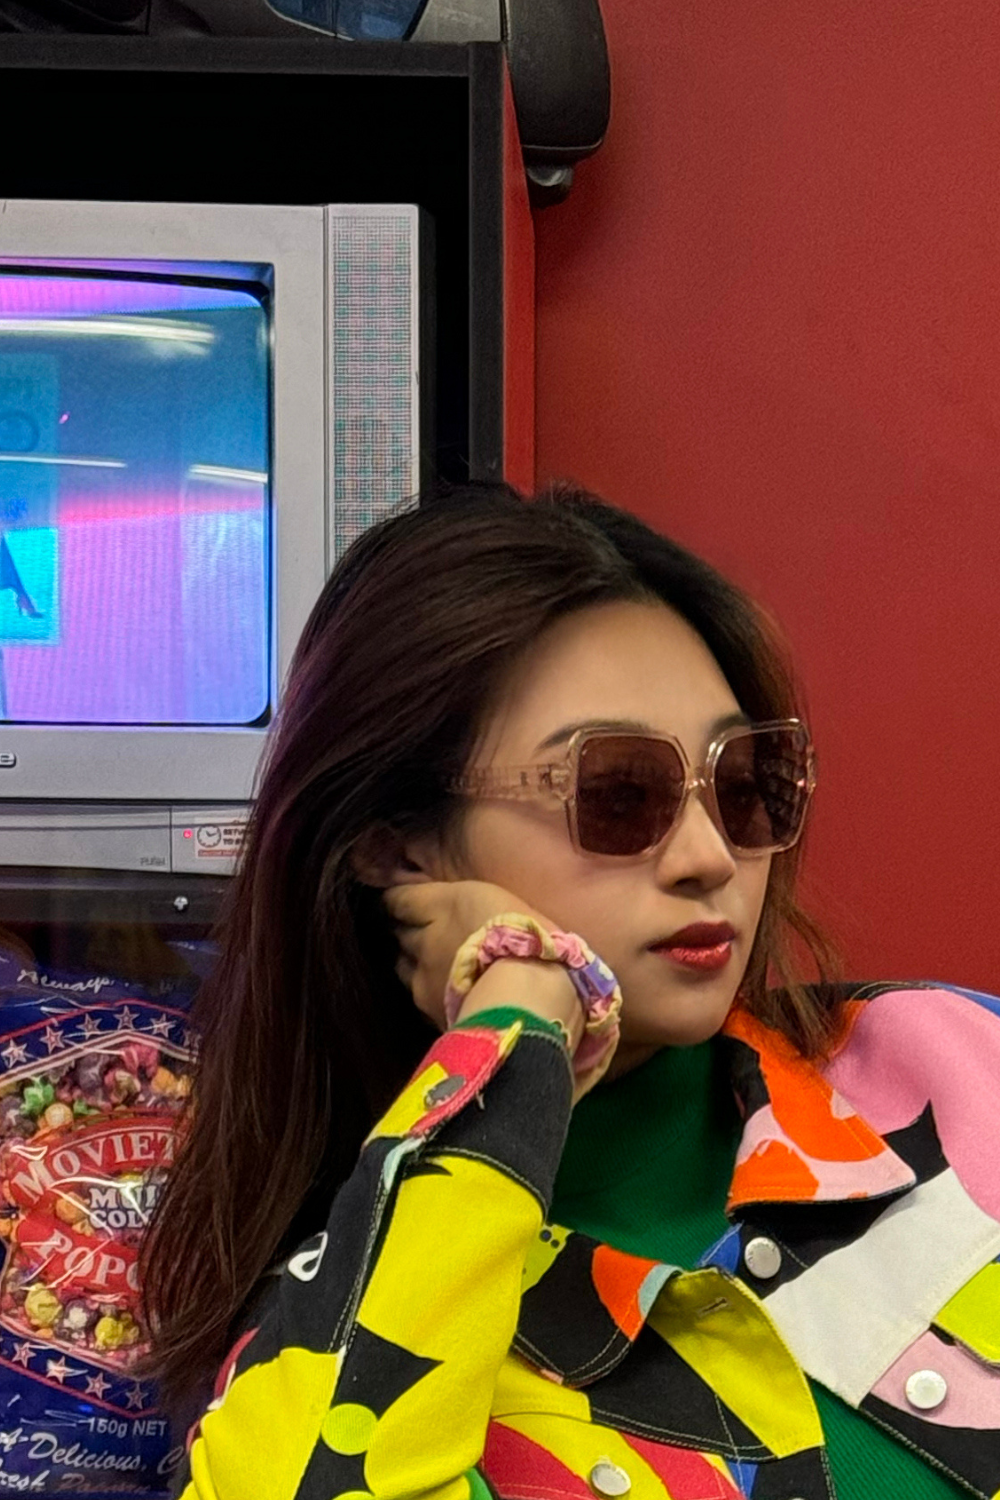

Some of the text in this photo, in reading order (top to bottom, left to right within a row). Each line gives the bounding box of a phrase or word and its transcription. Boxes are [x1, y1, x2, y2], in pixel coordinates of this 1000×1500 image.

[12, 1131, 176, 1205] MOVIET
[34, 1228, 140, 1290] POPC
[88, 1417, 168, 1438] 150g NET
